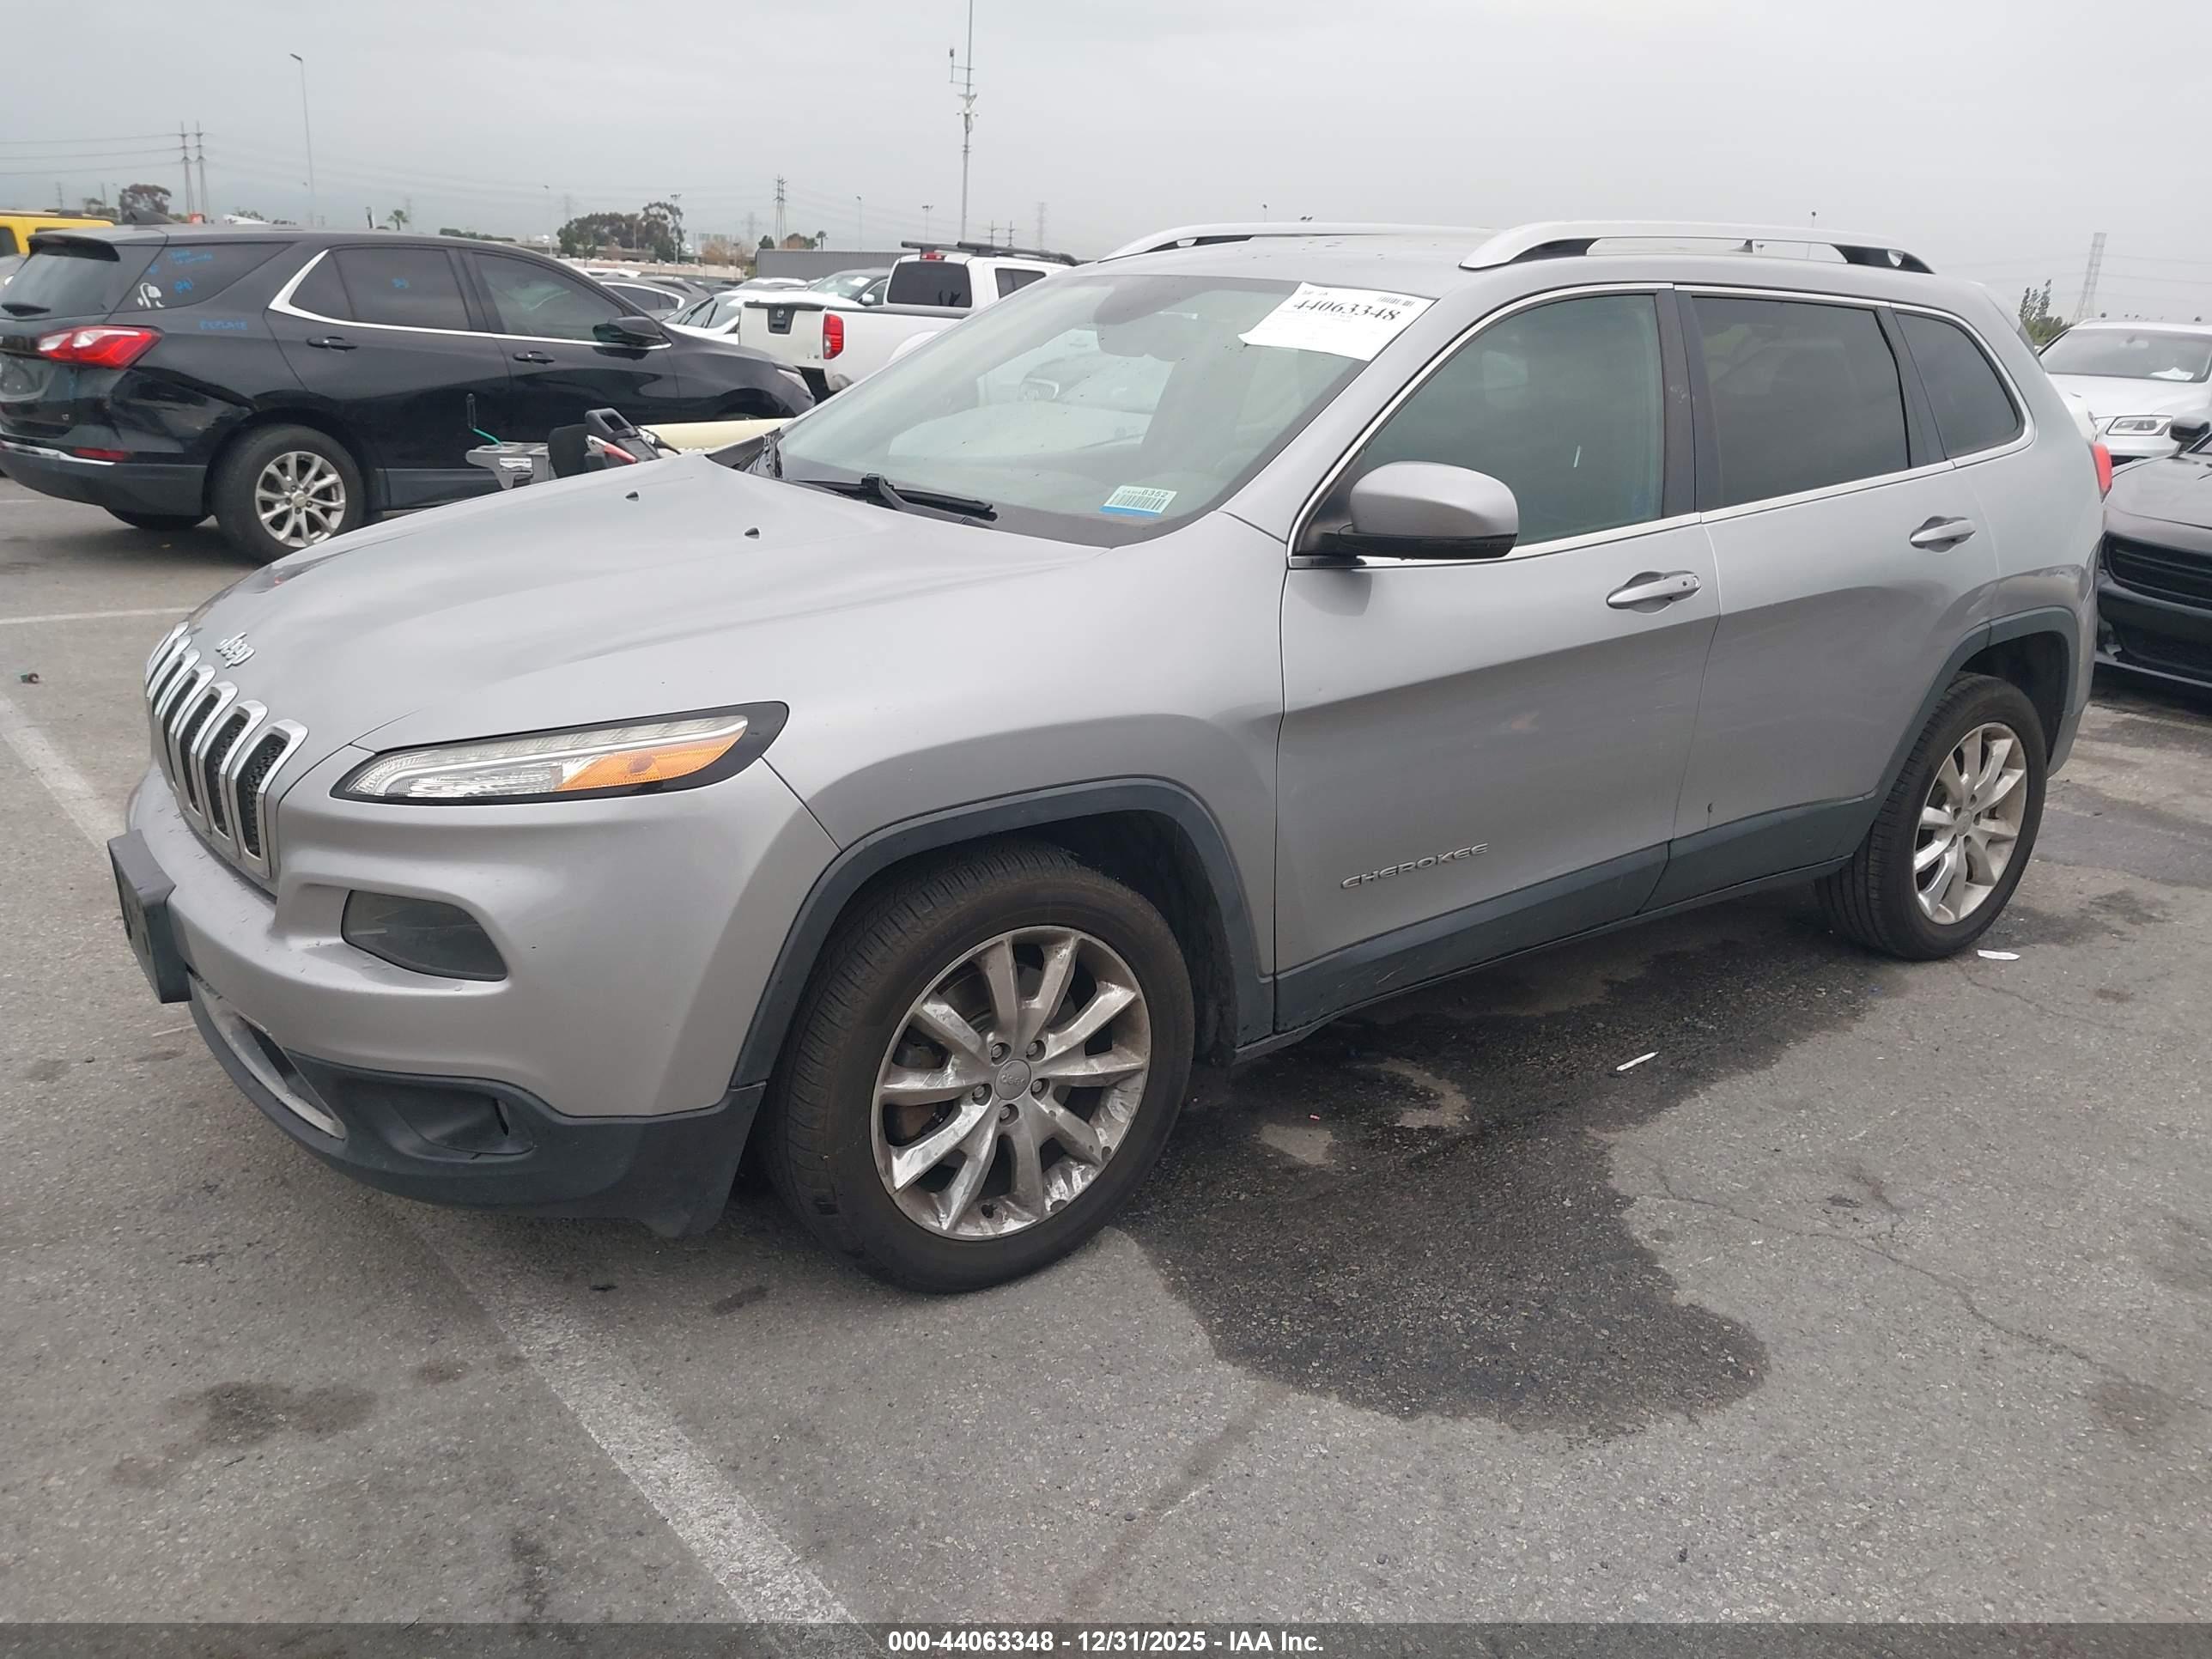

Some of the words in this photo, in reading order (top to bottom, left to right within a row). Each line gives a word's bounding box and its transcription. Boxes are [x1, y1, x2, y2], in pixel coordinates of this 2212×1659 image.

[1293, 300, 1401, 321] 44063348
[215, 631, 256, 668] Jeep
[1340, 842, 1489, 889] CHEROKEE
